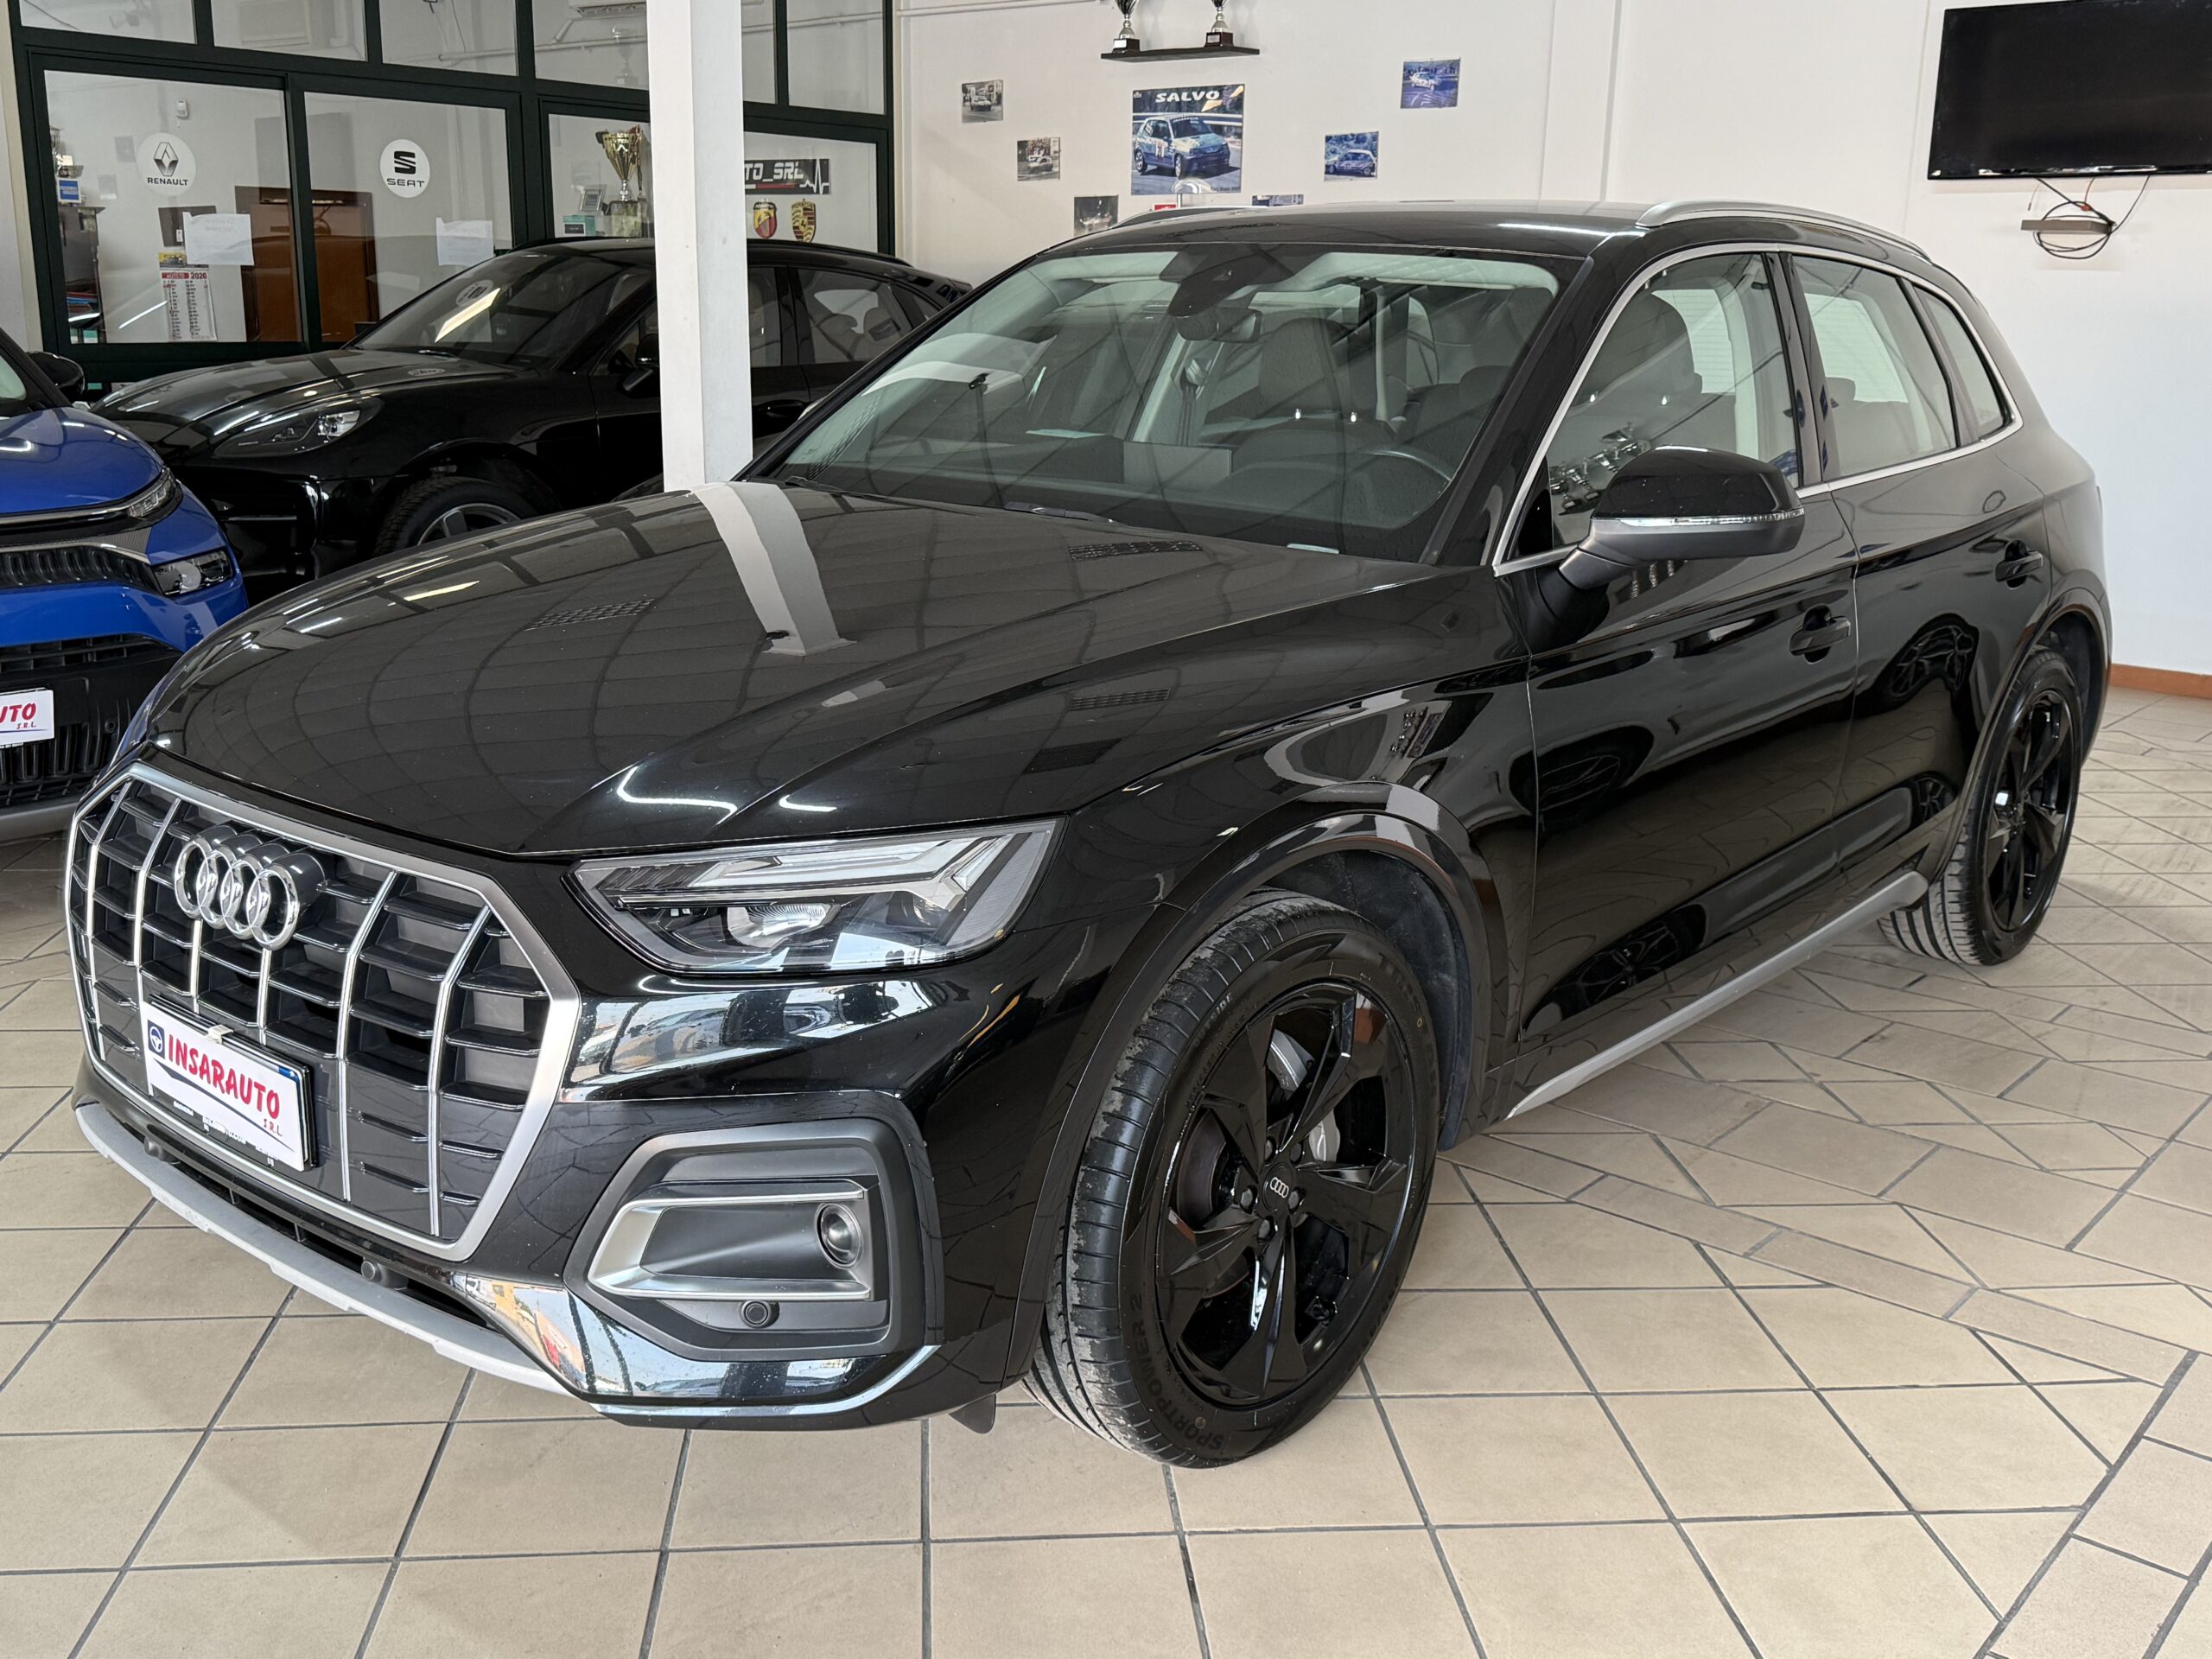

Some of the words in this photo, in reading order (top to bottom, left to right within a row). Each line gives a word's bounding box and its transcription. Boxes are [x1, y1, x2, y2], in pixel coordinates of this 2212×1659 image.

[1155, 91, 1220, 103] SALVO
[147, 177, 188, 186] RENAULT
[386, 178, 425, 188] SEAT
[168, 1034, 280, 1120] INSARAUTO
[264, 1118, 283, 1137] S.R.L.
[1132, 1319, 1225, 1450] SPORTPOWER
